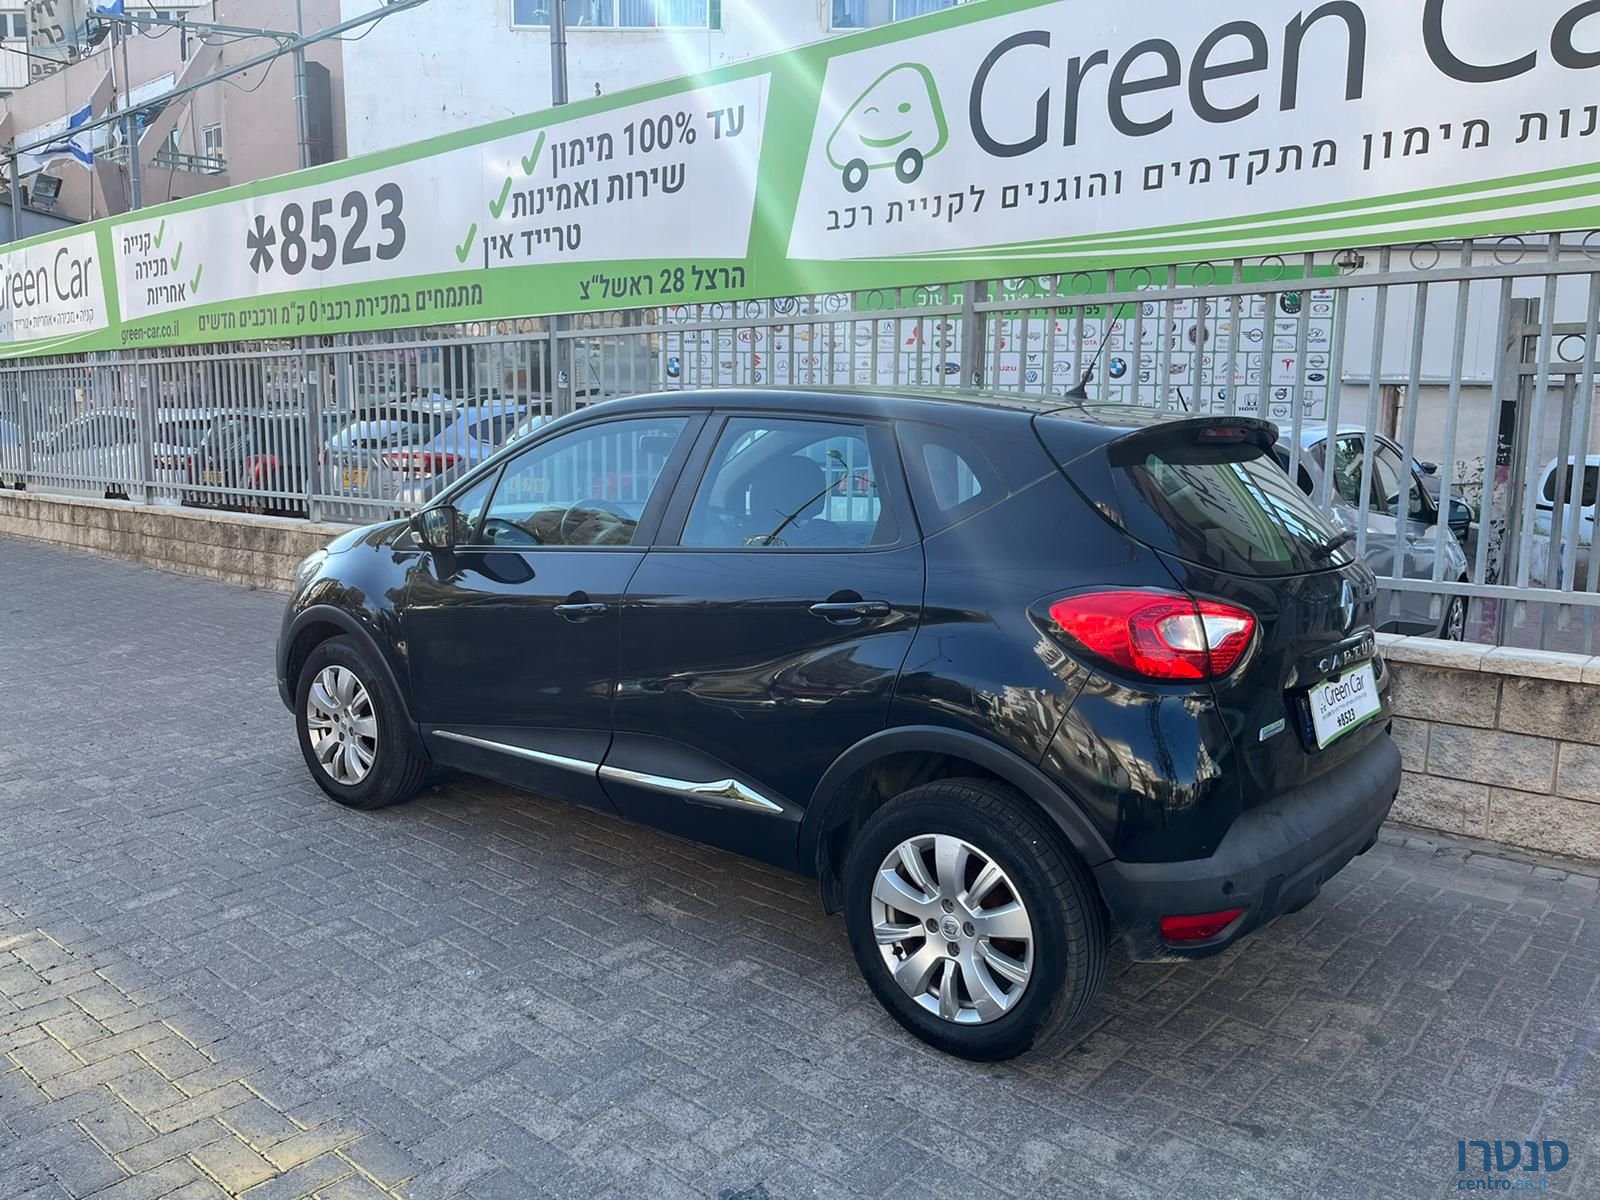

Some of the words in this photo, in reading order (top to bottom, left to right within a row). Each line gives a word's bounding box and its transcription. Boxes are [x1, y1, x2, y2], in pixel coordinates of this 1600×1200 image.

[969, 0, 1367, 158] Green
[623, 111, 697, 156] 100%
[706, 104, 745, 140] עד
[551, 132, 614, 179] מימון
[1361, 118, 1490, 171] מימון
[1143, 139, 1338, 191] מתקדמים
[511, 178, 599, 219] ואמינות
[606, 162, 686, 204] שירות
[1001, 169, 1123, 210] והוגנים
[826, 204, 874, 231] רכב
[885, 184, 986, 224] לקניית
[123, 232, 151, 256] קנייה
[482, 233, 514, 269] אין
[520, 222, 582, 257] טרייד
[54, 247, 93, 302] Car
[135, 257, 168, 280] מכירה
[659, 267, 685, 295] 28
[691, 264, 746, 292] הרצל
[146, 282, 186, 306] אחריות
[355, 292, 411, 318] במכירת
[415, 283, 483, 312] מתמחים
[198, 312, 236, 331] חדשים
[239, 309, 278, 328] ורכבים
[309, 300, 318, 322] 0
[324, 301, 351, 322] רכבי
[121, 320, 180, 345] green-car.co.il
[1324, 681, 1351, 706] Green
[1349, 673, 1365, 694] Car
